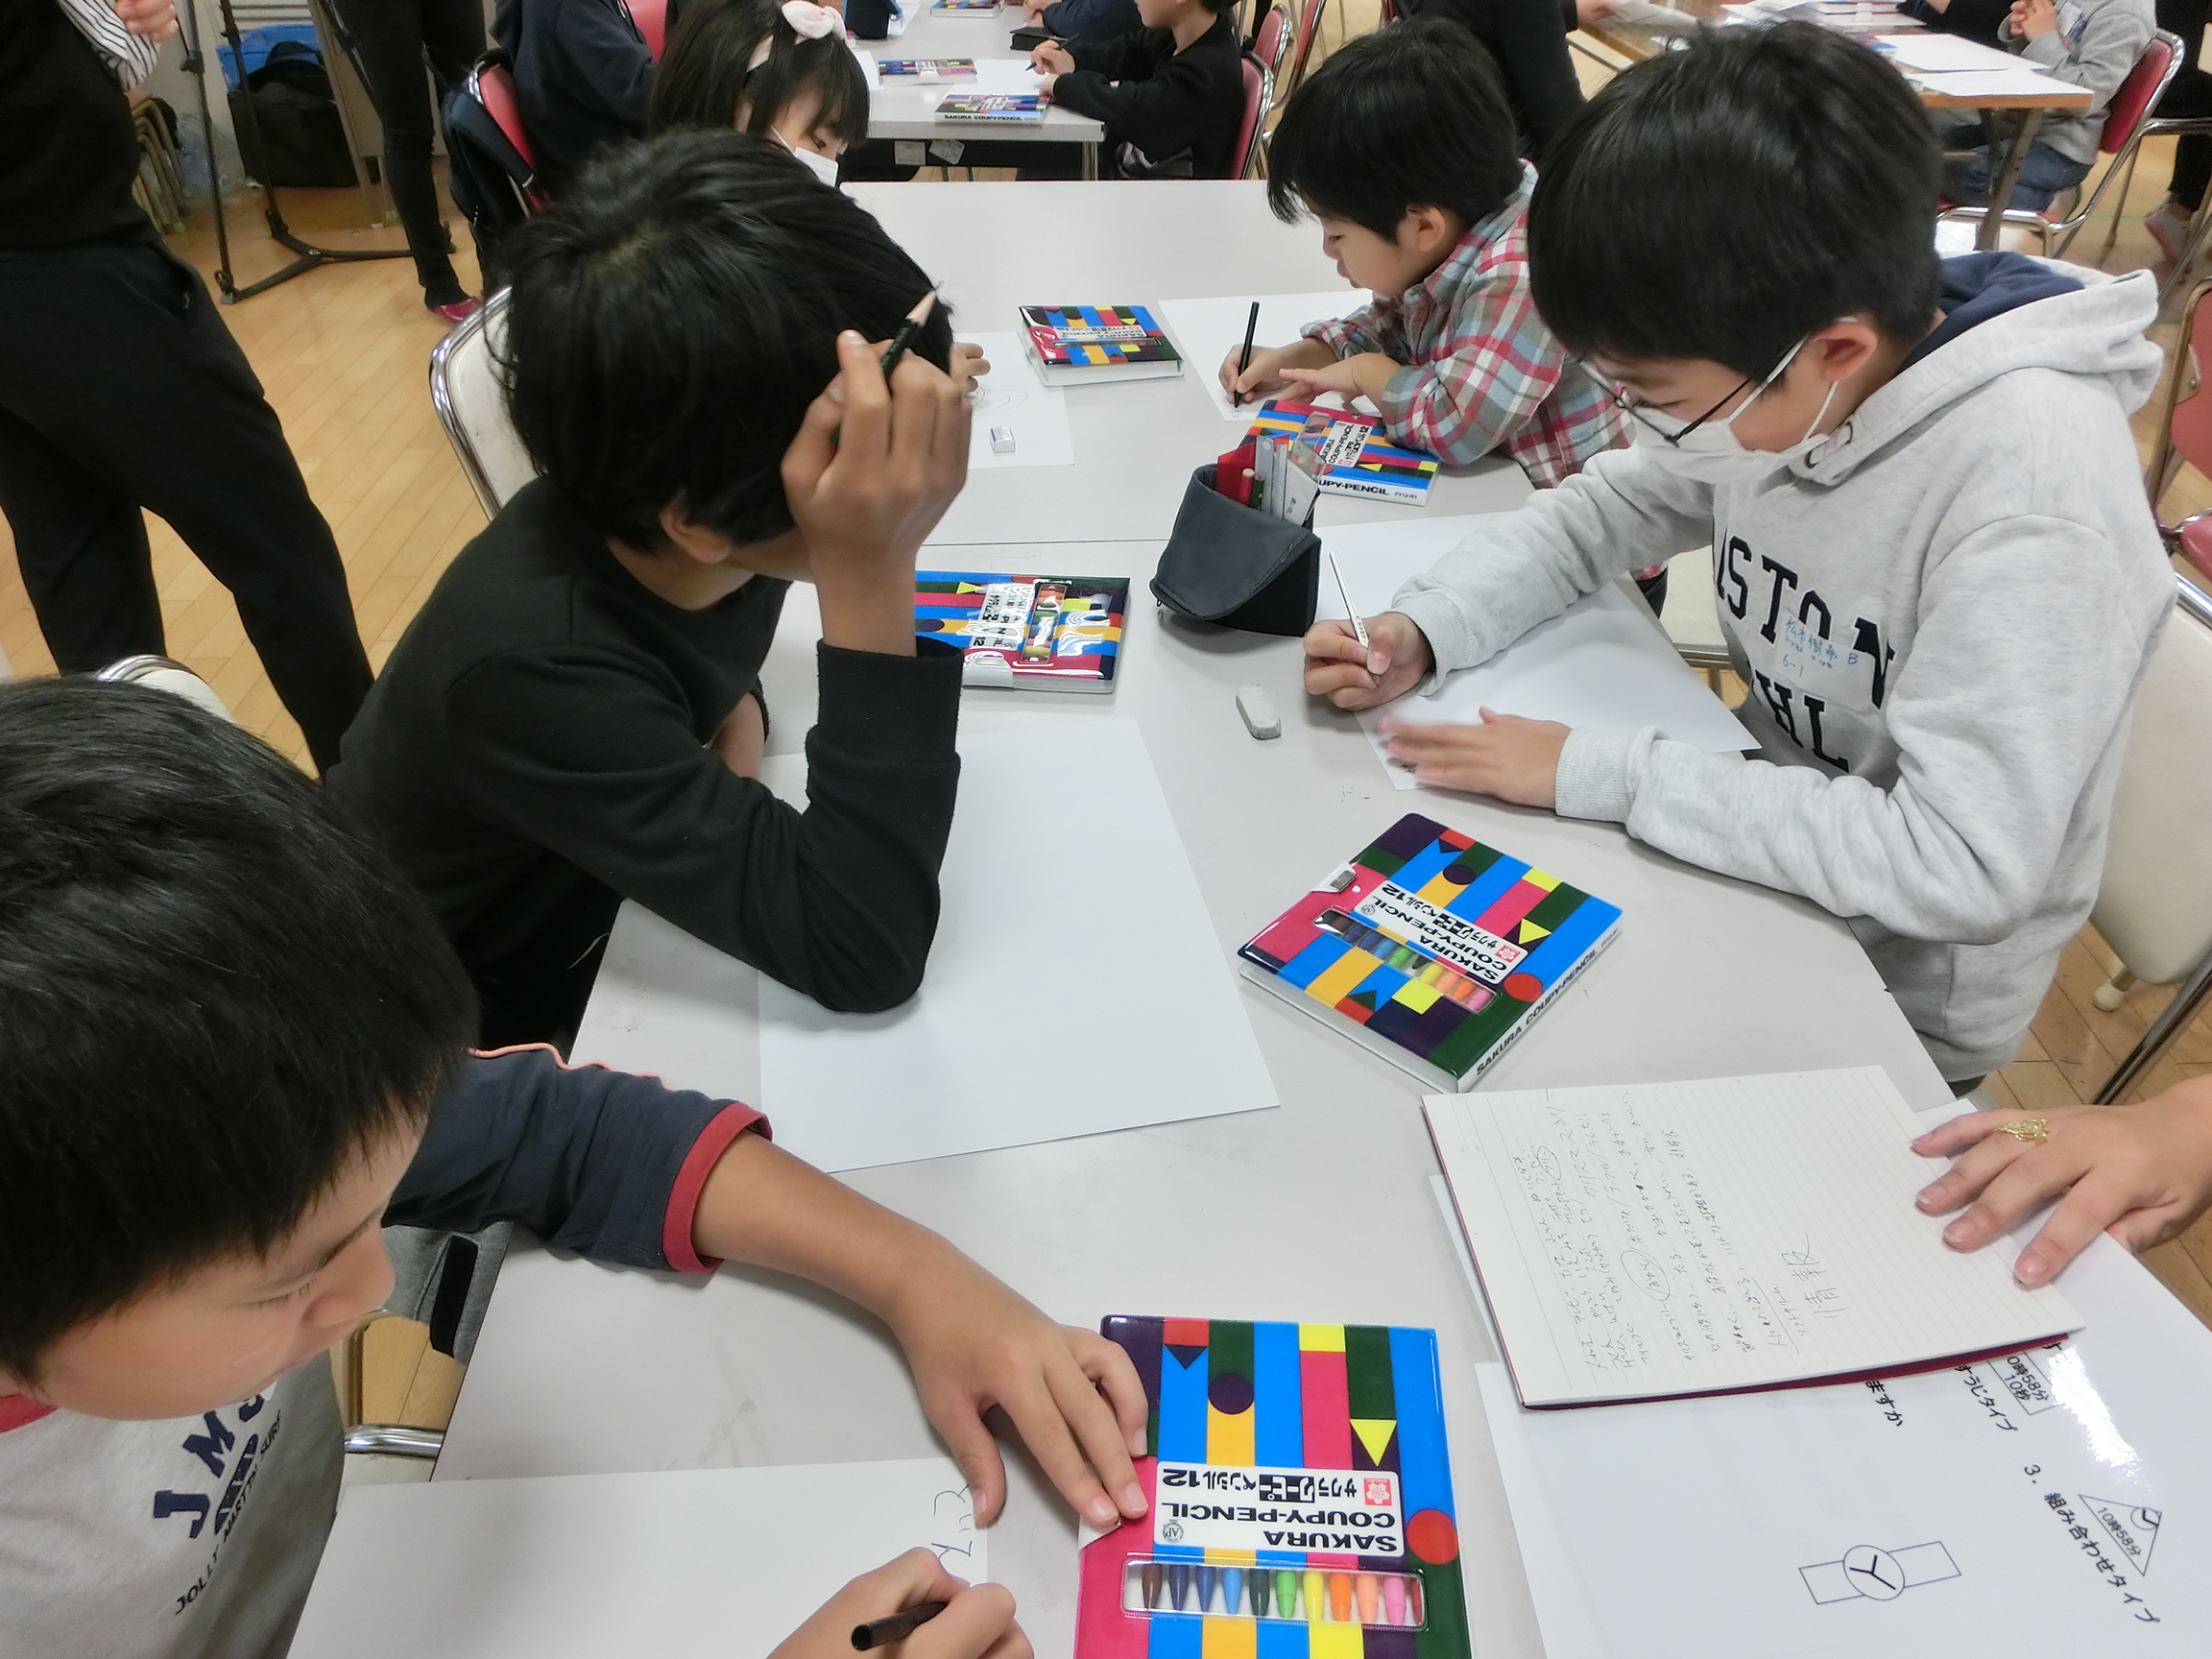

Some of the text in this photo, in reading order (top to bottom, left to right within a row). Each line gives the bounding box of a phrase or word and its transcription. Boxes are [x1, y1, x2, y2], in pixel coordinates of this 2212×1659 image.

[1319, 439, 1335, 463] AKURA
[1318, 478, 1390, 496] UPY-PENCIL
[1747, 661, 1850, 774] HL
[1371, 896, 1508, 972] COUPY-PENCIL
[1419, 934, 1501, 981] SAKURA
[1476, 949, 1599, 1076] SAKURA COUPY-PENCIL
[1779, 1232, 1849, 1319] 情報
[2005, 1374, 2032, 1401] 10秒
[1161, 1502, 1396, 1528] COUPY-PENCIL
[2097, 1505, 2143, 1557] 10時58分
[1262, 1529, 1398, 1552] SAKURA
[2043, 1491, 2161, 1623] 組み合わせタイプ
